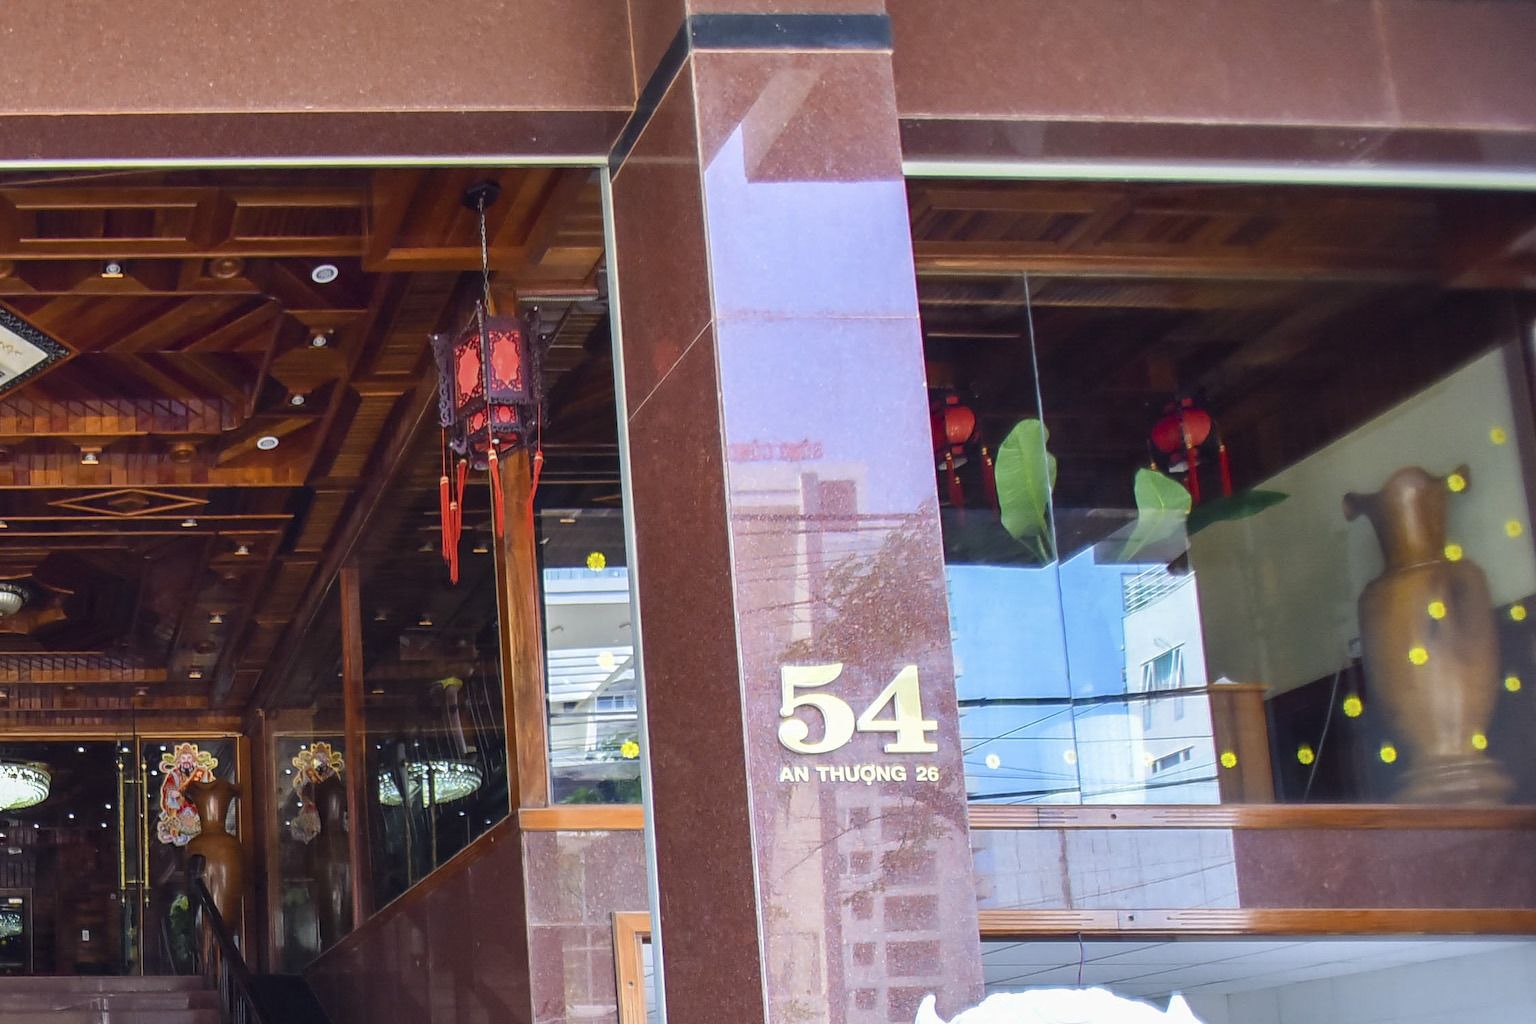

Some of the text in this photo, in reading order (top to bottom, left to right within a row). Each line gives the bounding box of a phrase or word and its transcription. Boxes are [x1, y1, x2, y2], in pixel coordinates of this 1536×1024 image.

[778, 663, 939, 755] 54
[779, 764, 940, 786] AN THƯỢNG 26
